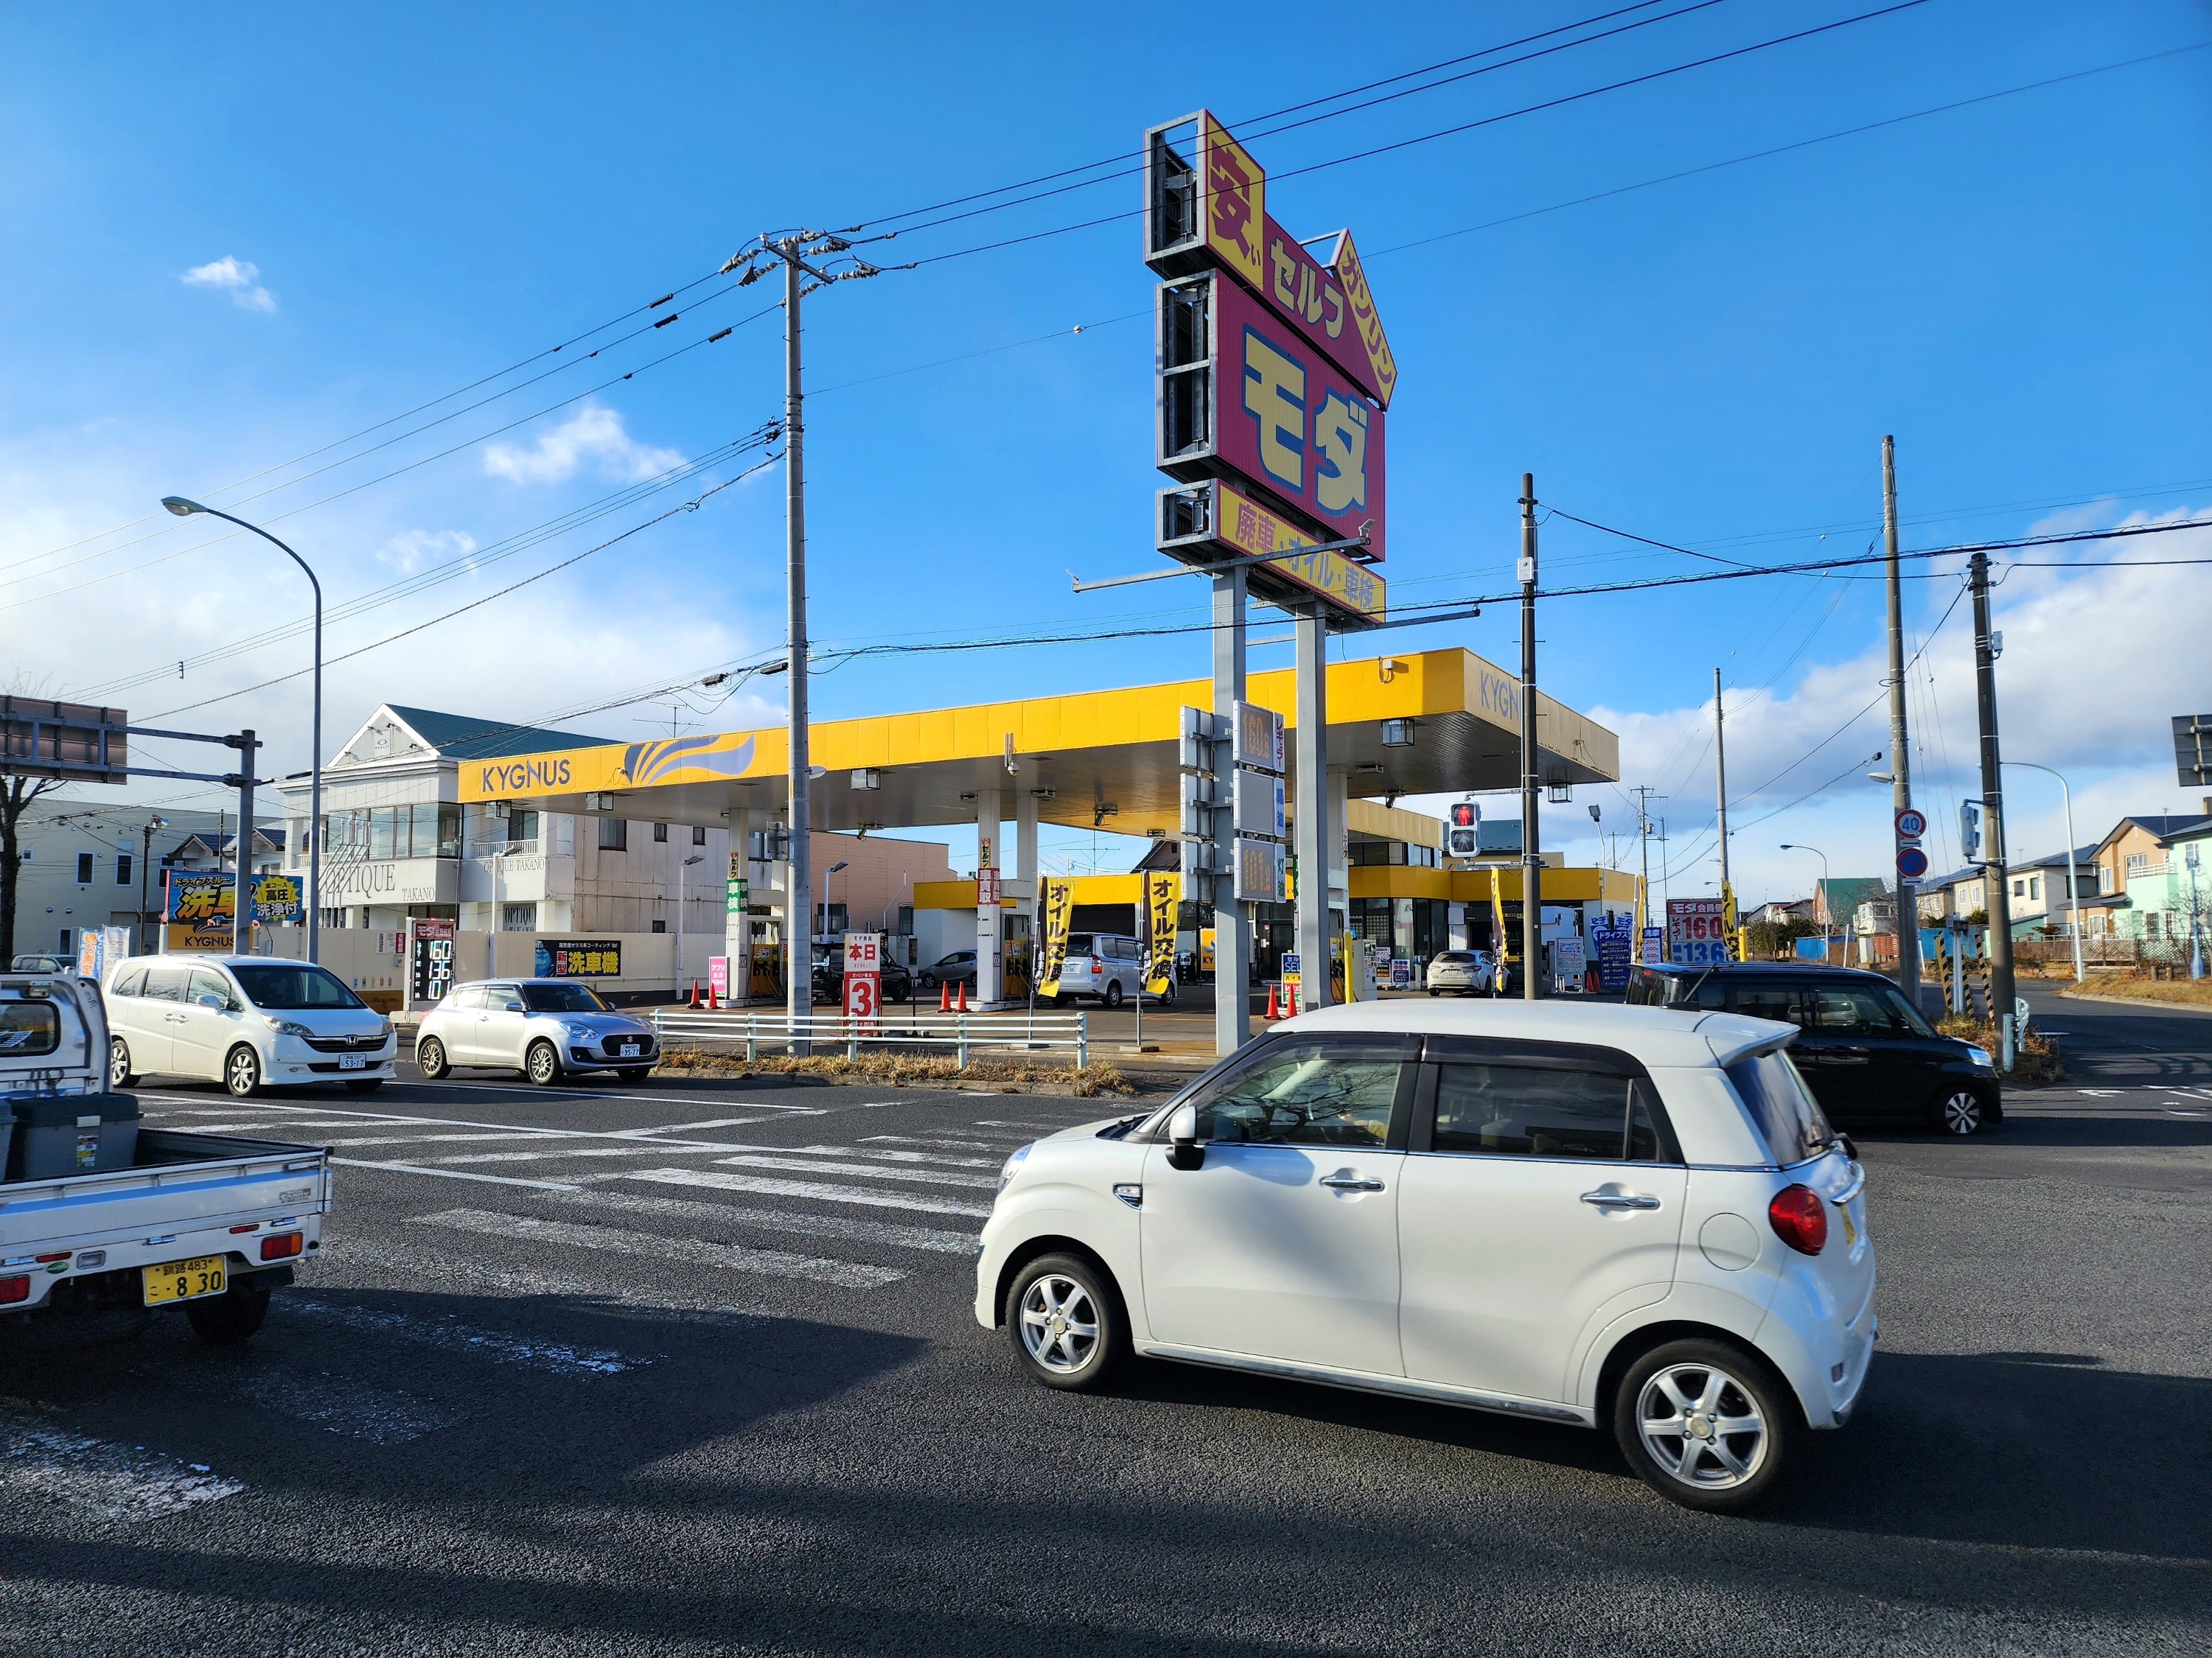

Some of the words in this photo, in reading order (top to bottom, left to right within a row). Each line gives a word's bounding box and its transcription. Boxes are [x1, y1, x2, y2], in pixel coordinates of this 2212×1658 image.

[1271, 237, 1344, 339] セルフ
[1341, 249, 1392, 384] ガソリン
[1243, 329, 1368, 510] モダ
[1481, 670, 1521, 721] KYGN
[483, 758, 571, 792] KYGNUS
[1276, 788, 1284, 828] 軽油
[1902, 817, 1919, 830] 40
[484, 860, 514, 875] OPIQUE
[515, 858, 545, 870] TAKANO
[174, 875, 231, 887] ドライブスルー
[980, 870, 991, 903] 車買取
[1277, 857, 1285, 897] 灯油
[266, 889, 288, 901] 高圧
[402, 886, 435, 902] TAKANO
[728, 882, 739, 909] 車検
[256, 900, 298, 917] 洗浄付
[505, 906, 536, 925] OPTIQU
[1672, 903, 1722, 914] モダ会員価
[1152, 879, 1175, 980] オイル交換
[1599, 931, 1628, 940] ドライブス
[1644, 929, 1660, 937] 洗車
[1683, 916, 1723, 940] 160
[568, 951, 618, 973] 洗車機
[849, 943, 876, 961] 本日
[1683, 942, 1725, 962] 136
[557, 952, 566, 973] 新型
[1285, 962, 1300, 972] SEL
[851, 982, 871, 1018] 3
[345, 1060, 364, 1068] 53-17
[187, 1259, 208, 1271] 483
